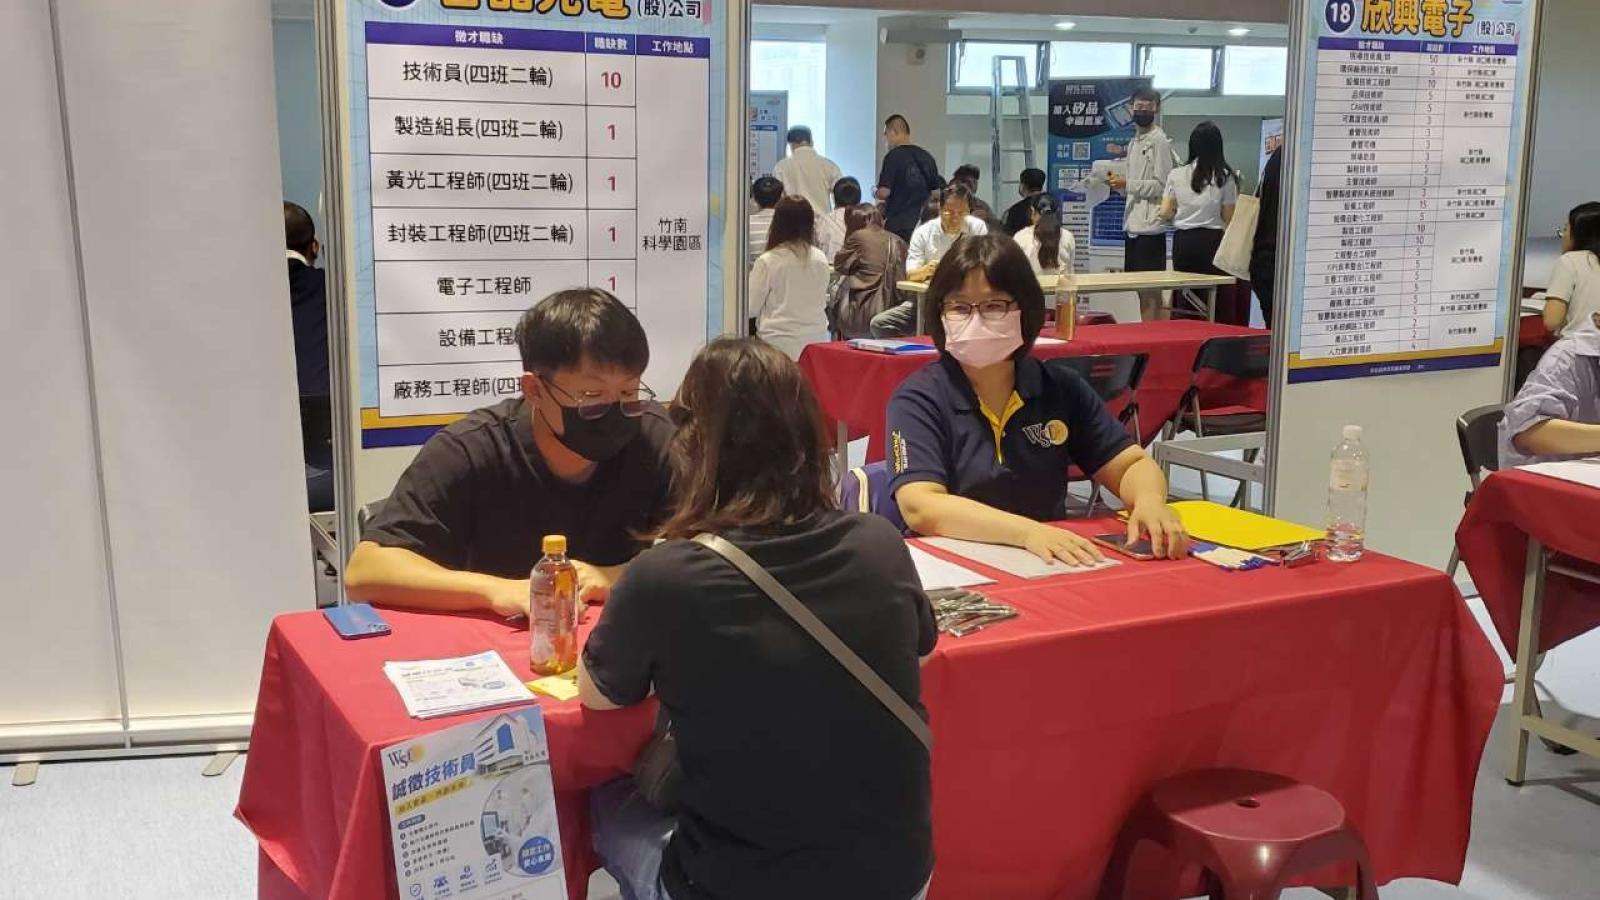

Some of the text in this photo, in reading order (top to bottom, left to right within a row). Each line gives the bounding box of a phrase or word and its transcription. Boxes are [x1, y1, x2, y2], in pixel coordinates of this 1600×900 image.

[637, 0, 701, 18] (股)公司
[1330, 2, 1351, 23] 18
[1360, 0, 1474, 37] 欣興電子
[455, 29, 503, 45] 徵才職缺
[1477, 21, 1516, 37] (股)公司
[594, 37, 627, 50] 職缺數
[651, 39, 694, 54] 工作地點
[1429, 55, 1439, 64] 50
[402, 60, 553, 87] 技術員(四班二輪)
[600, 71, 621, 88] 10
[1428, 79, 1437, 88] 10
[394, 115, 563, 142] 製造組長(四班二輪)
[607, 124, 616, 141] 1
[385, 169, 574, 193] 黃光工程師(四班二輪)
[607, 175, 616, 191] 1
[658, 218, 687, 233] 竹南
[387, 224, 575, 246] 封裝工程師(四班二輪)
[608, 227, 617, 242] 1
[641, 234, 702, 251] 科學園區
[436, 276, 531, 296] 電子工程師
[608, 276, 617, 291] 1
[392, 752, 475, 800] 誠徵技術員
